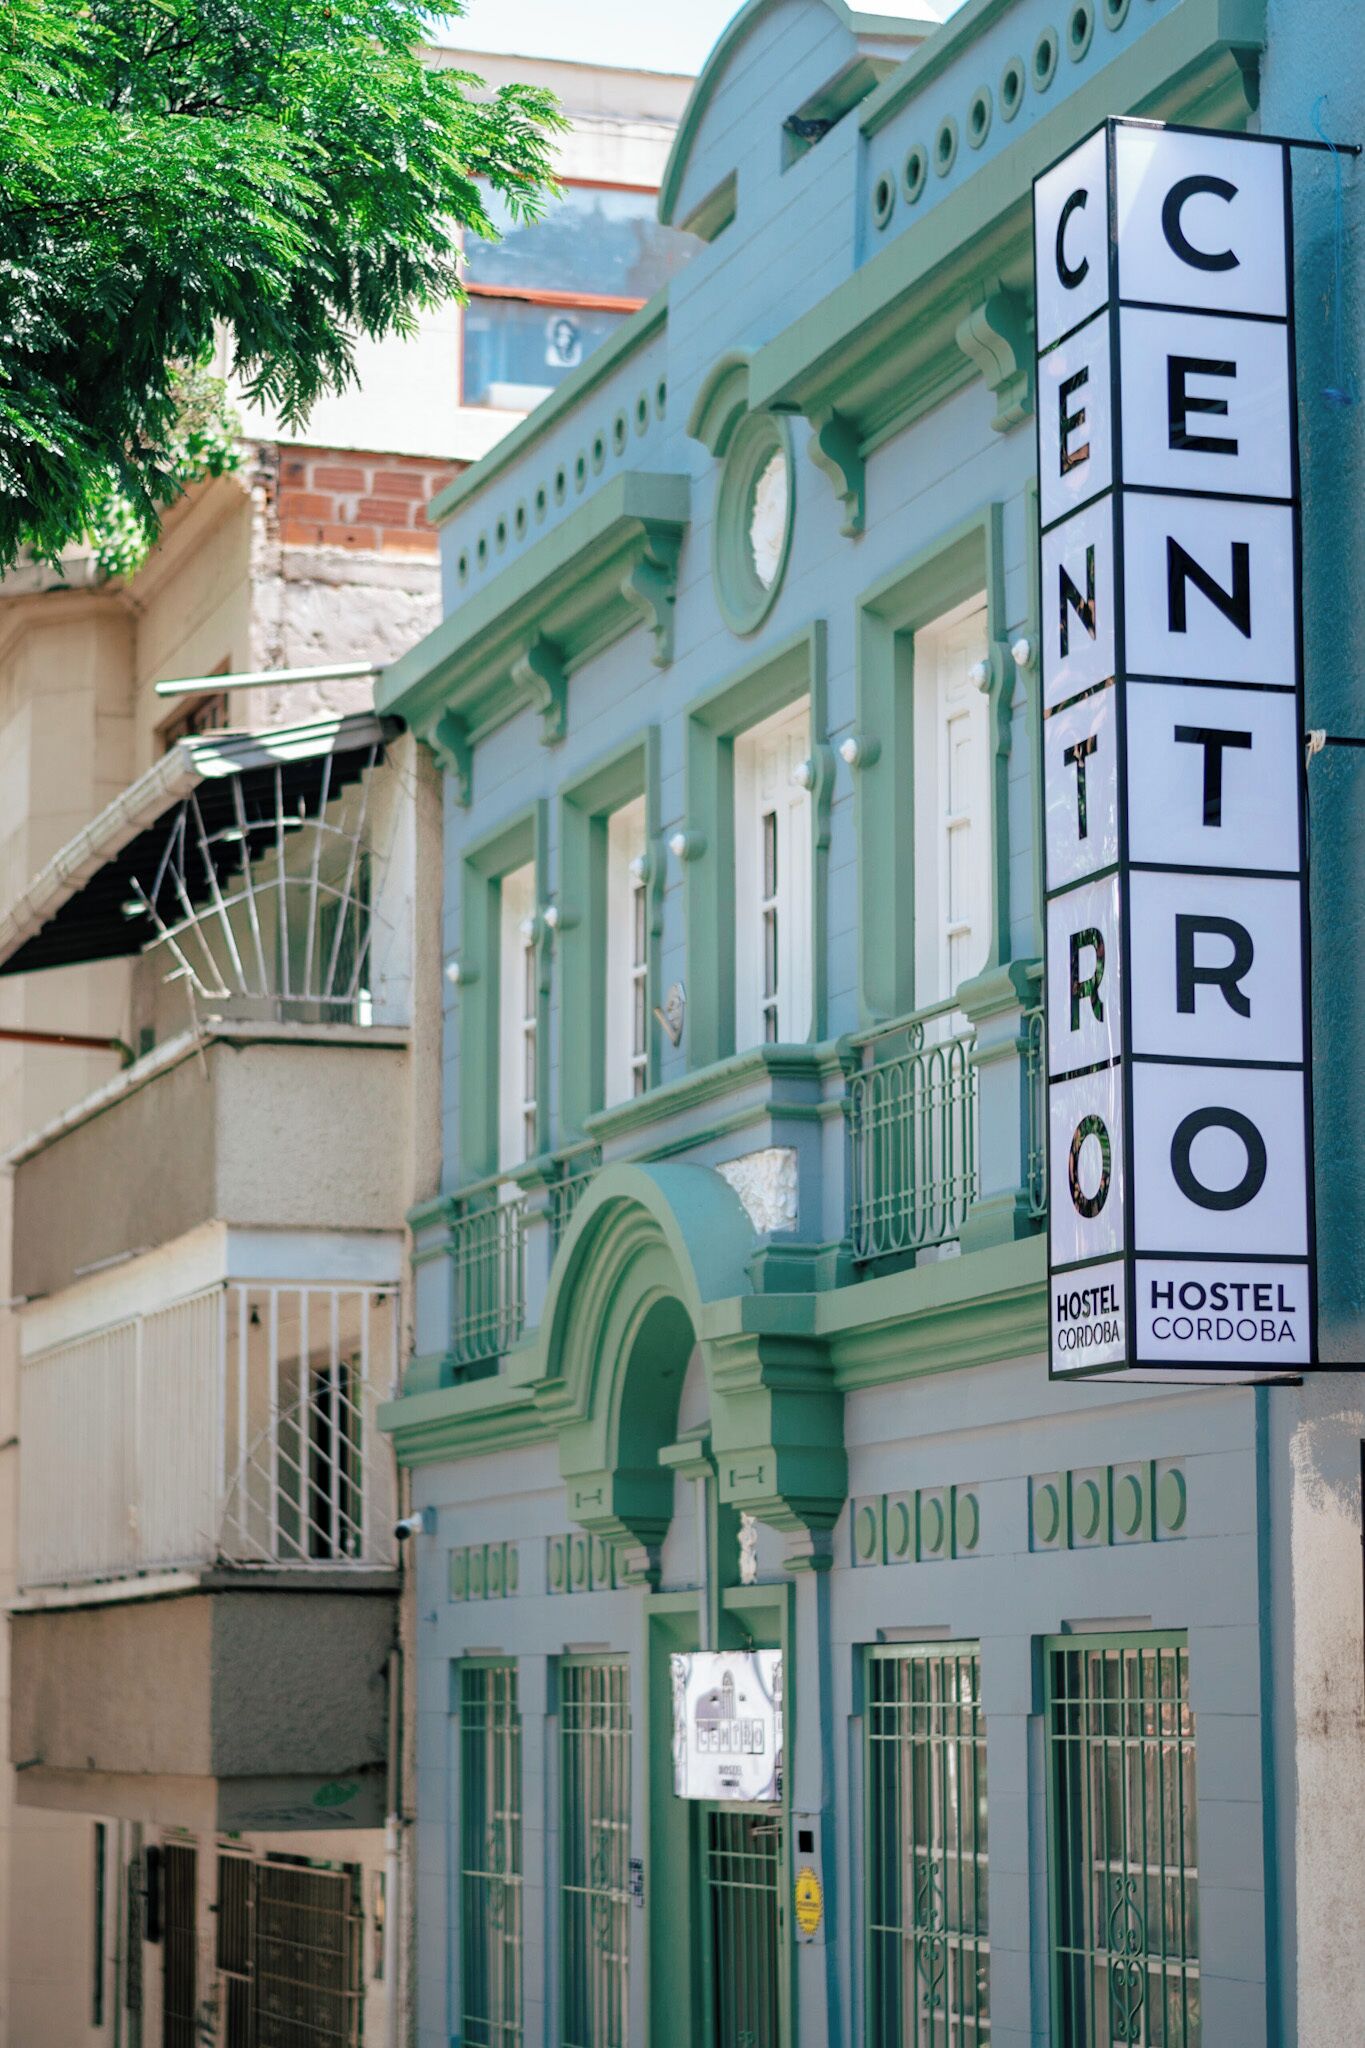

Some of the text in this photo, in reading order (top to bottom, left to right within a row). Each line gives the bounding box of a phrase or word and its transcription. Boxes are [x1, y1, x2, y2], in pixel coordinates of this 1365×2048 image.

[1055, 188, 1111, 1218] CENTRO
[1161, 174, 1267, 1211] CENTRO
[1057, 1284, 1120, 1322] HOSTEL
[1151, 1280, 1297, 1312] HOSTEL
[1058, 1319, 1120, 1351] CORDOBA
[1152, 1316, 1297, 1343] CORDOBA
